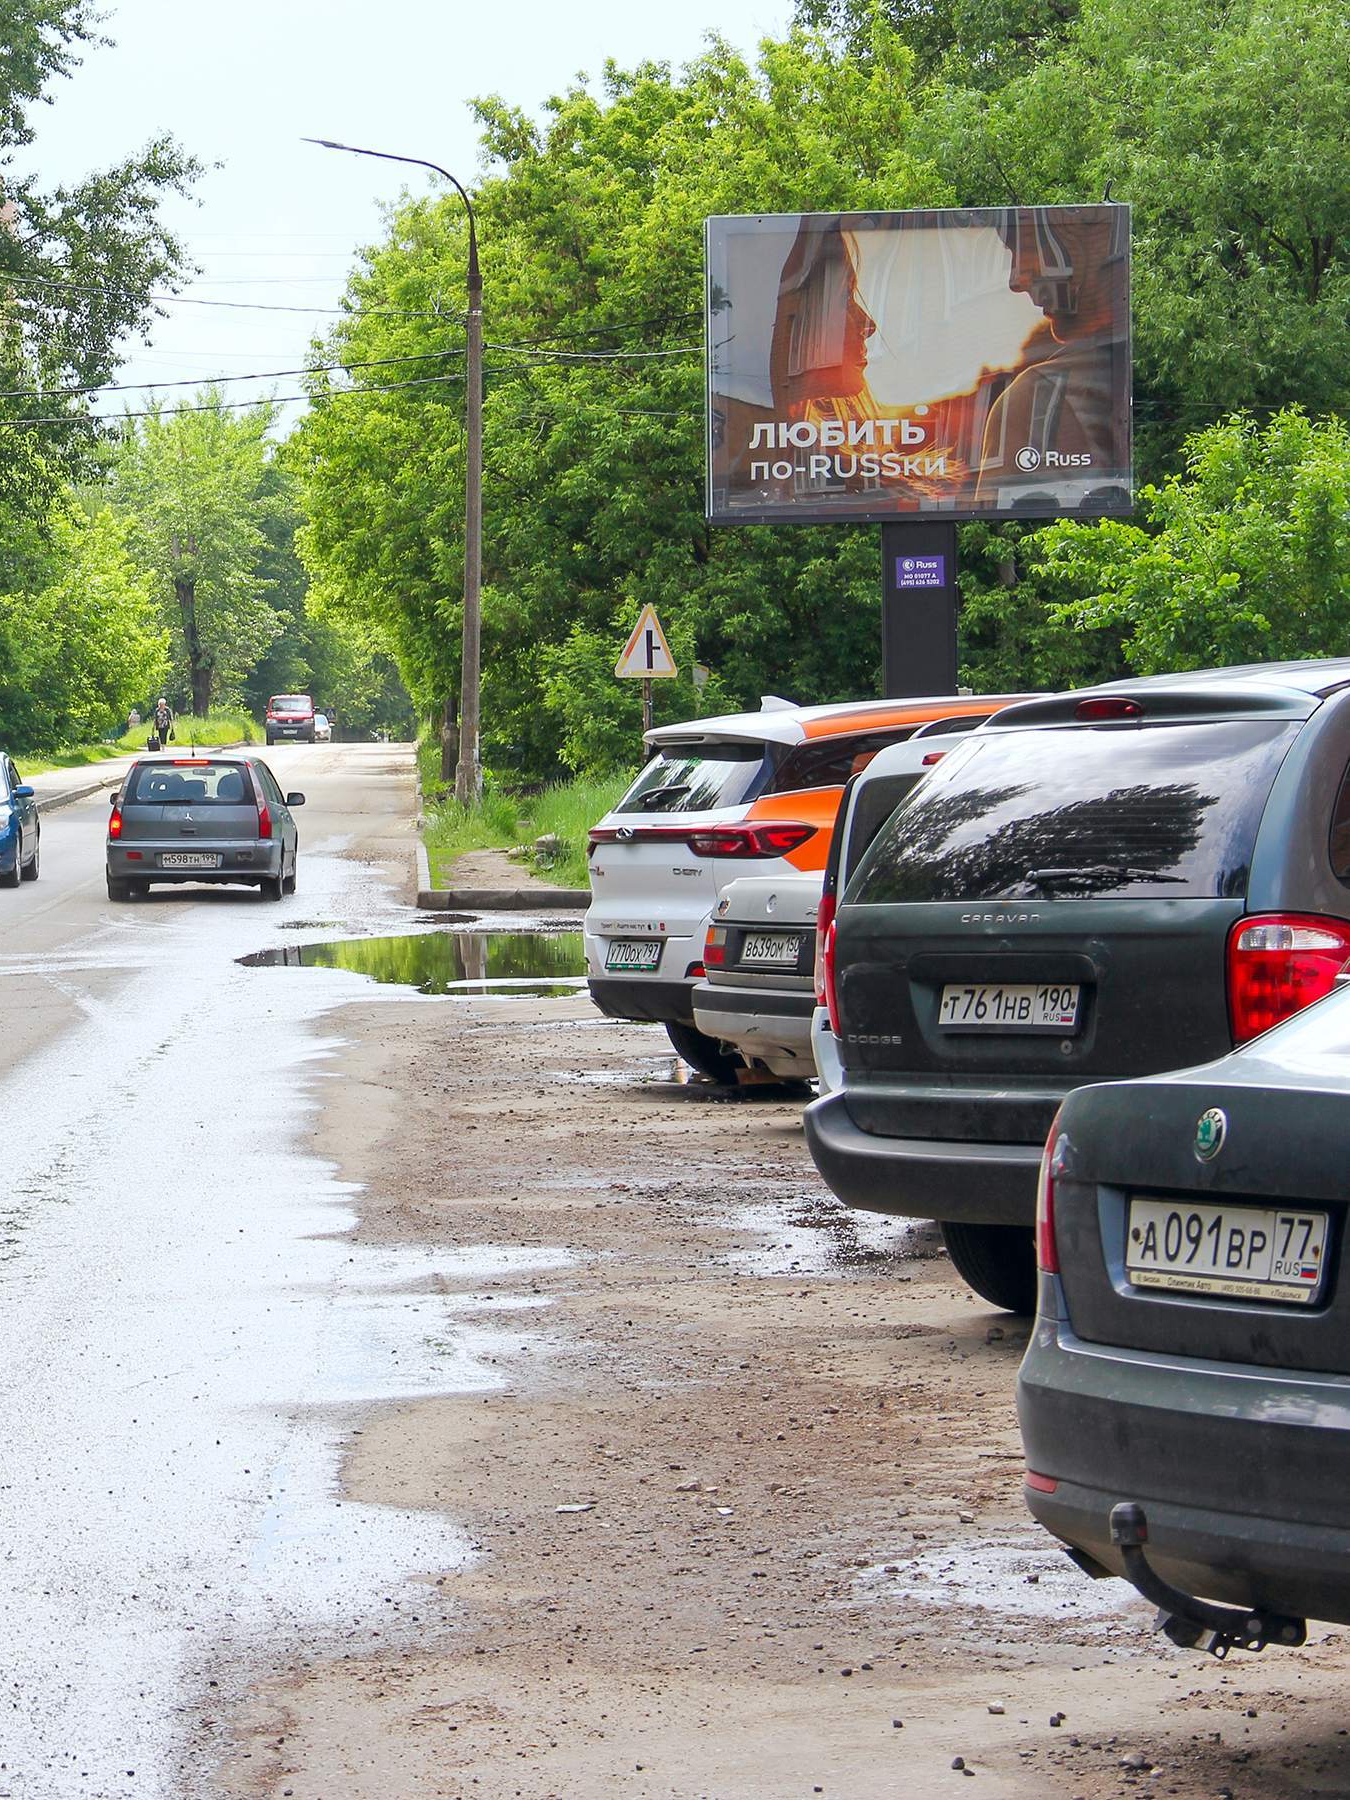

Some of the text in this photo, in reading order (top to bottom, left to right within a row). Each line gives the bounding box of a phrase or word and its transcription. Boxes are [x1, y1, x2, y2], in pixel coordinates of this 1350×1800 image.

[749, 419, 925, 449] ЛЮБИТЬ
[1045, 451, 1091, 466] Russ
[751, 453, 946, 481] по-RUSSки
[916, 561, 937, 569] Russ
[644, 944, 659, 960] 797
[949, 988, 1072, 1020] Т761НВ 190
[1042, 1013, 1060, 1021] RUS
[848, 1034, 902, 1045] DODGE
[1141, 1211, 1314, 1269] А091ВР 77
[1274, 1260, 1300, 1276] RUS
